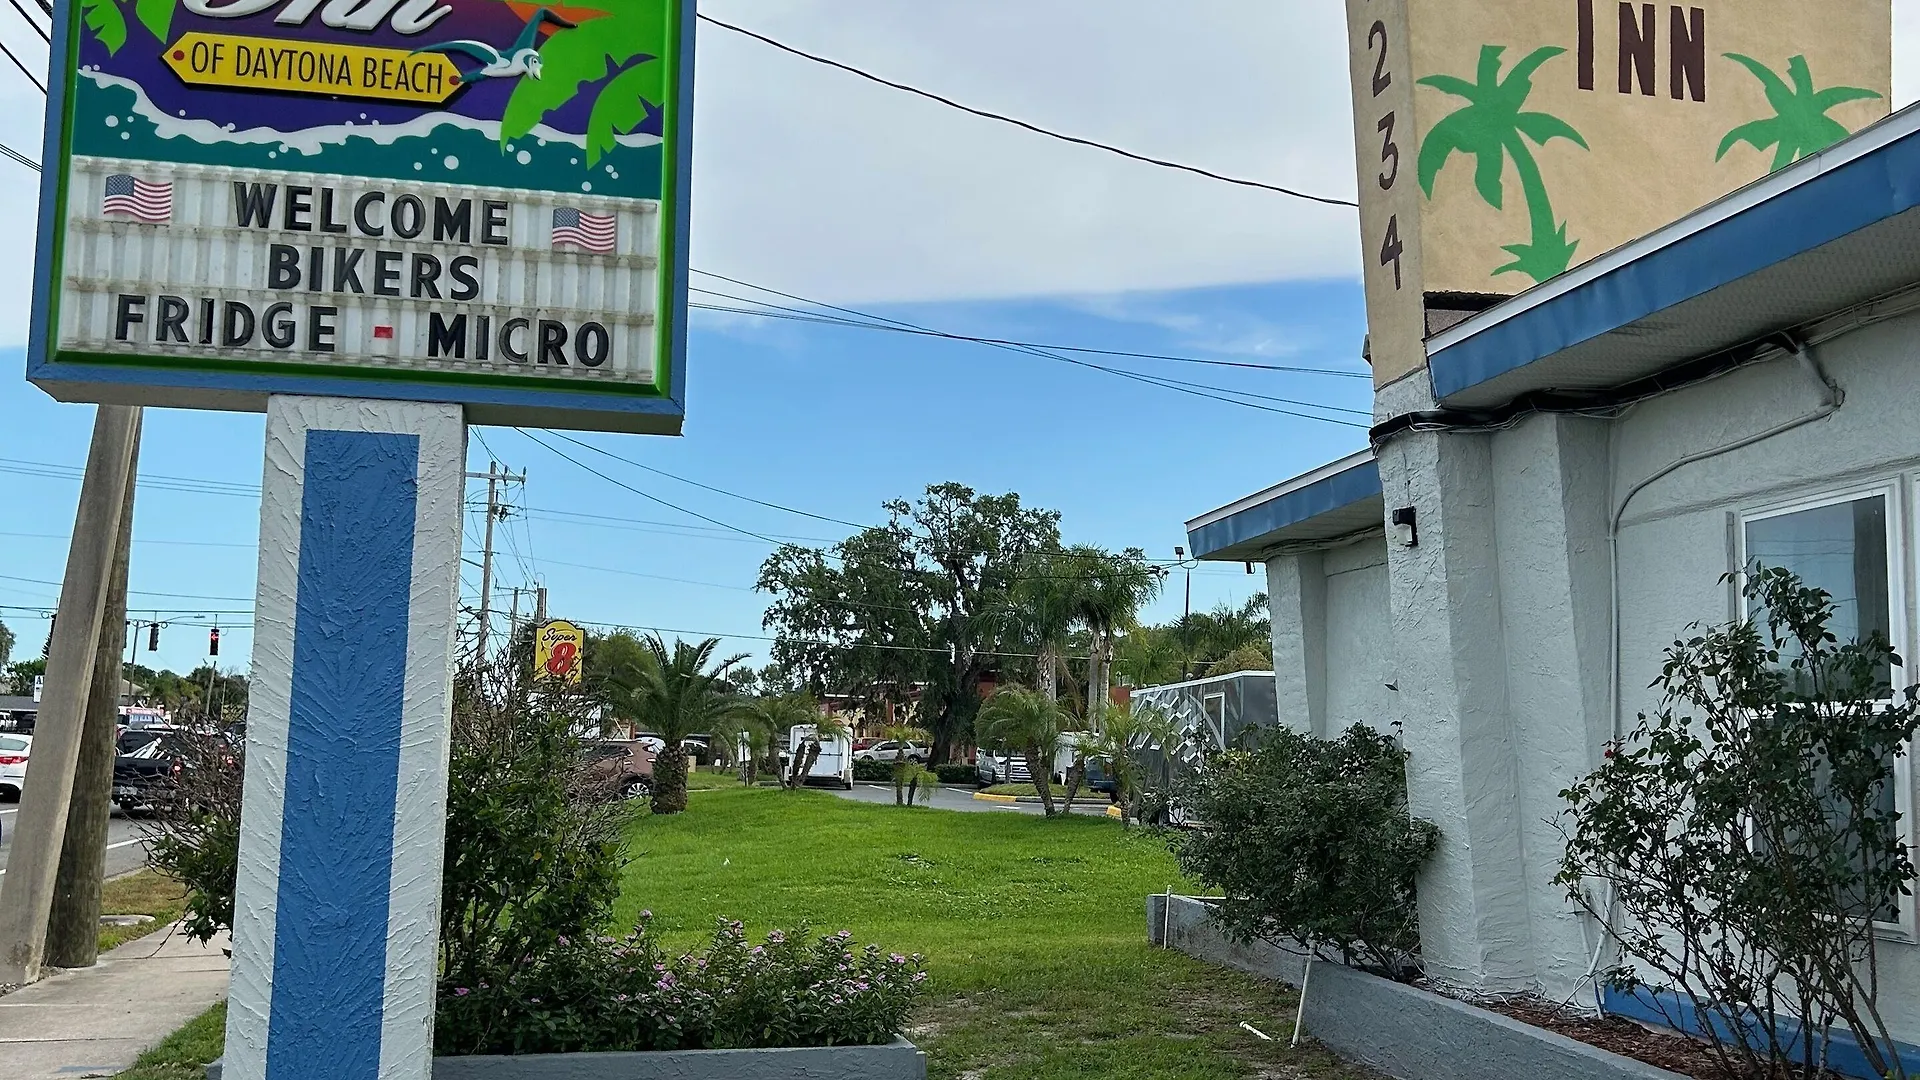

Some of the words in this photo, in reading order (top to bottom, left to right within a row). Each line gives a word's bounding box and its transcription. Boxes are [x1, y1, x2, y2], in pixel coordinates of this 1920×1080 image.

[191, 41, 225, 75] OF
[235, 45, 352, 87] DAYTONA
[362, 57, 443, 95] BEACH
[1577, 0, 1706, 103] INN
[1366, 0, 1403, 291] 234
[233, 181, 509, 246] WELCOME
[268, 243, 480, 300] BIKERS
[115, 294, 339, 353] FRIDGE
[428, 312, 610, 368] MICRO
[542, 628, 577, 647] Super
[545, 642, 577, 676] 8
